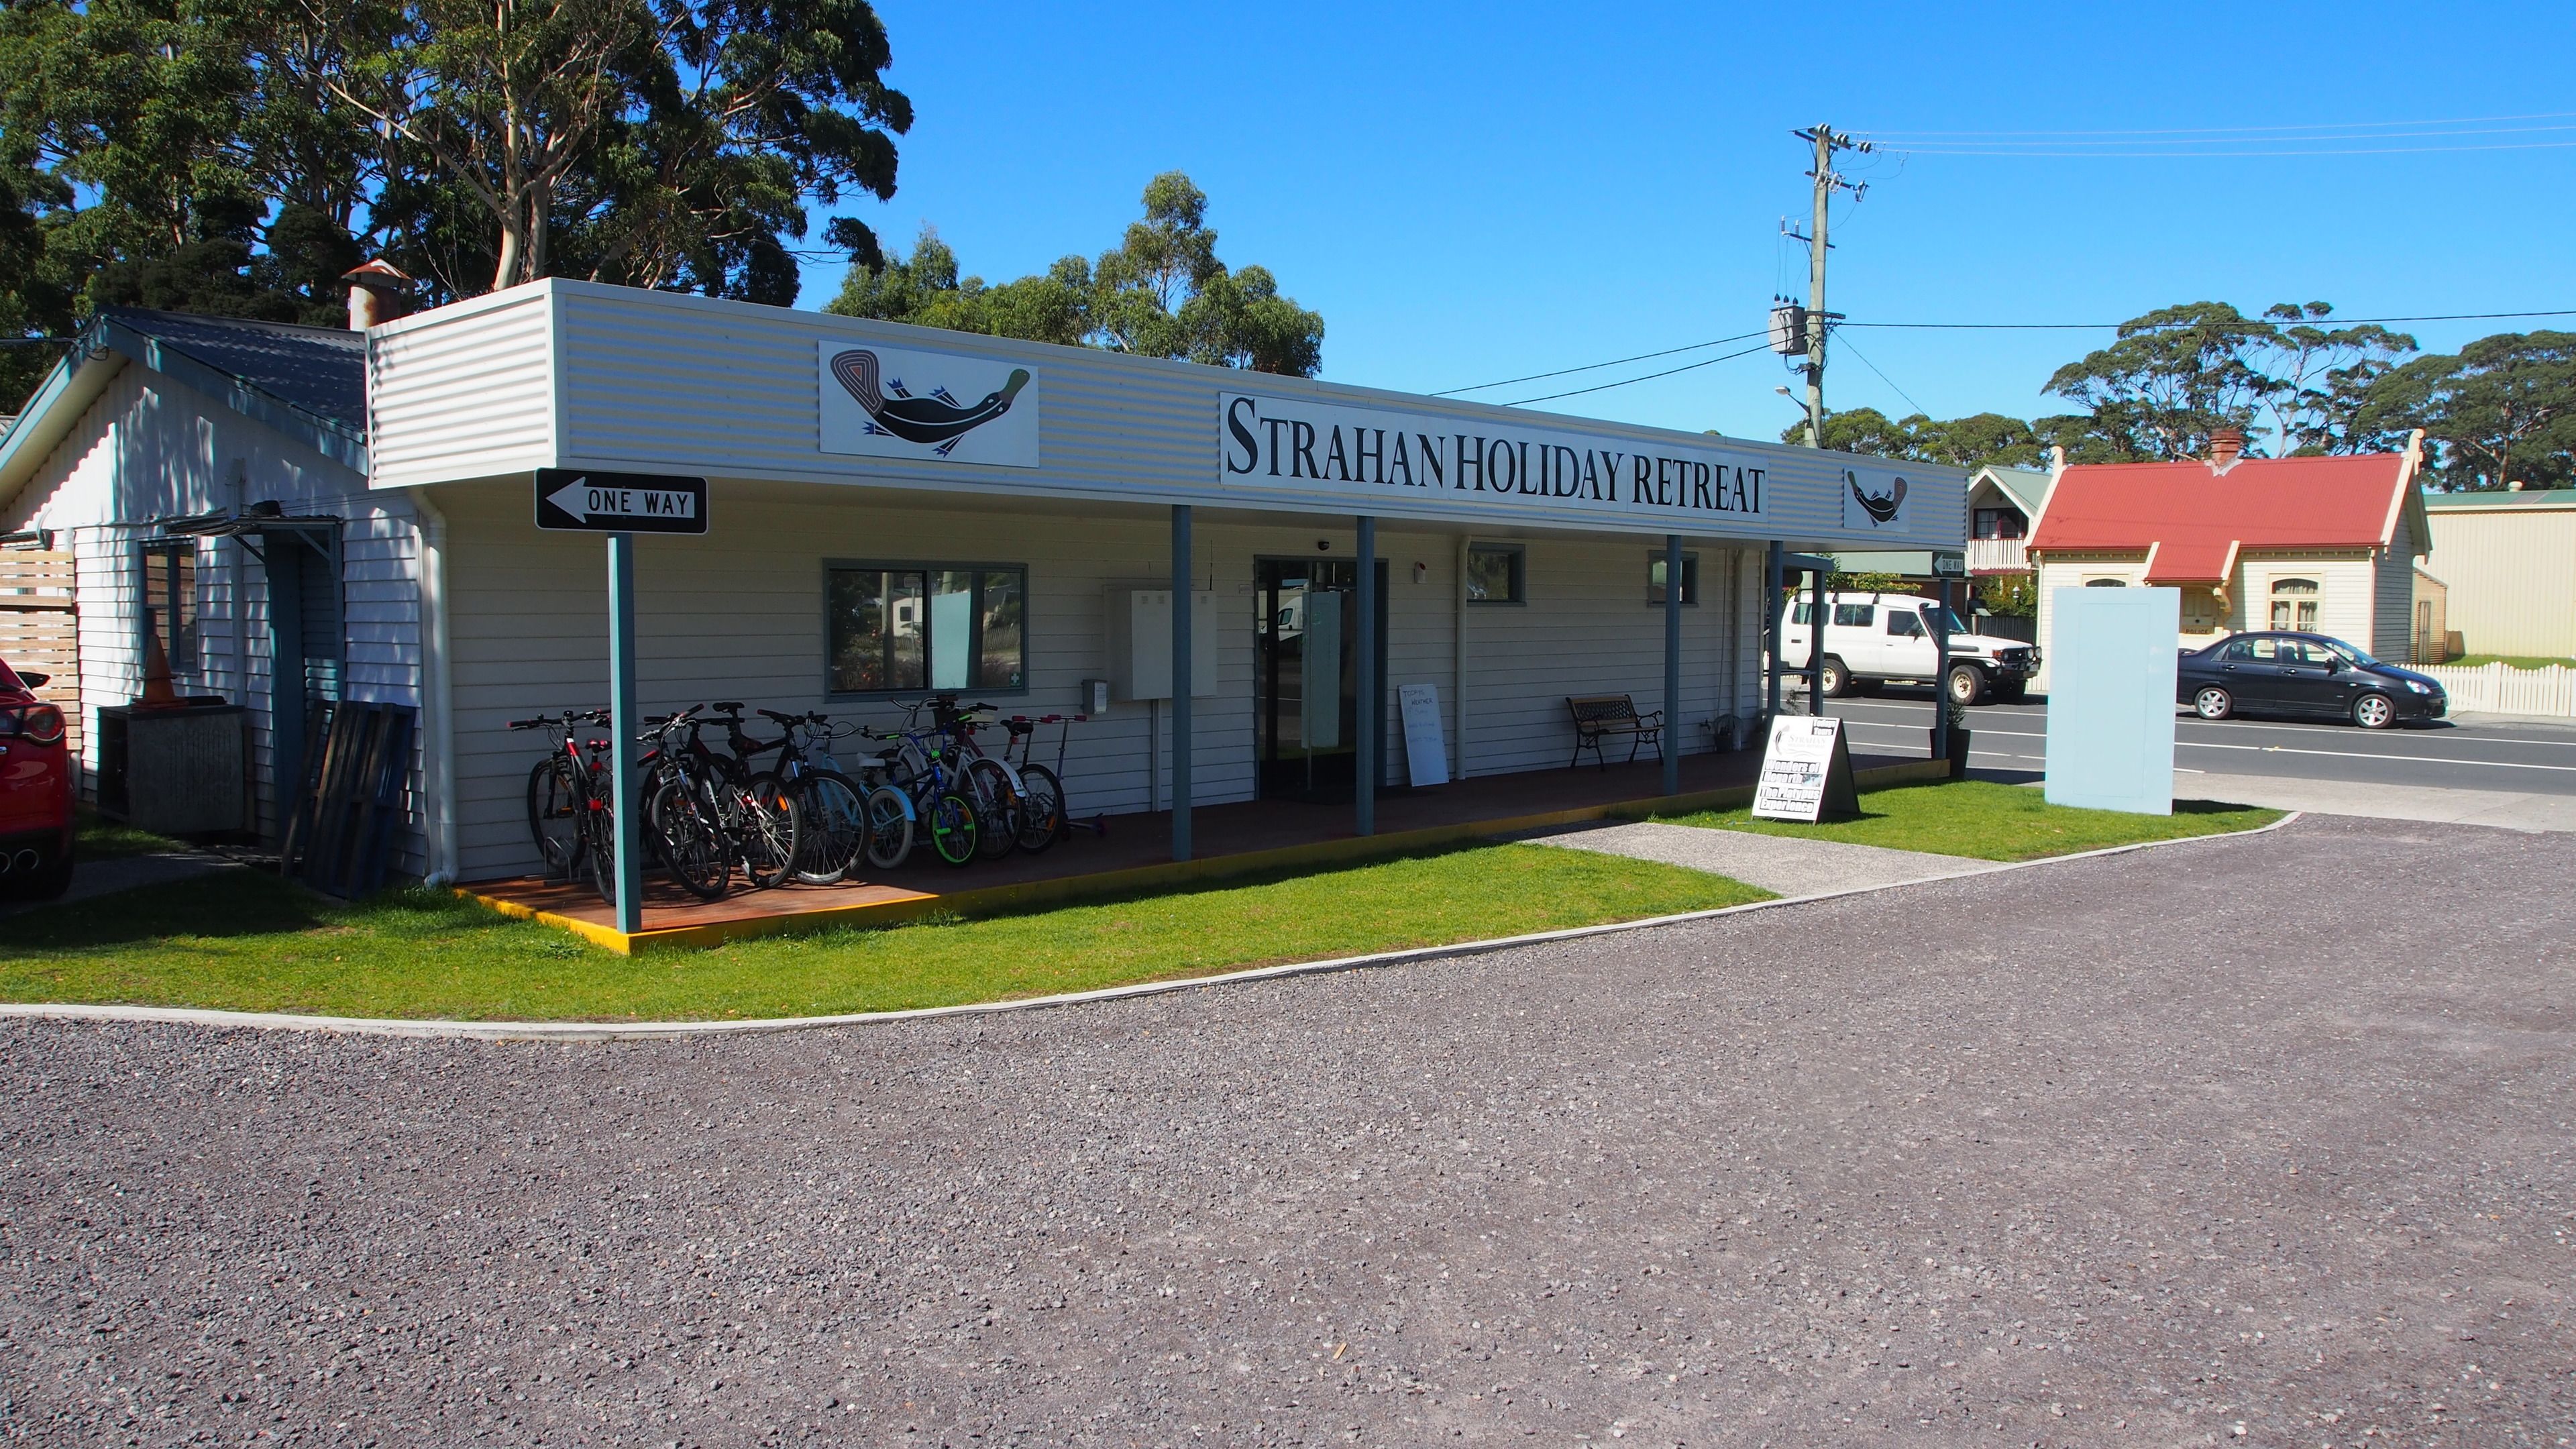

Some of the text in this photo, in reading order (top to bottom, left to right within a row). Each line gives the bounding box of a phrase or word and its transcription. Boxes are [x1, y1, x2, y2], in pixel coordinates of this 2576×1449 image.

[1228, 397, 1765, 514] STRAHAN HOLIDAY RETREAT
[588, 489, 688, 515] ONE WAY
[1943, 559, 1952, 570] ONE
[1813, 727, 1833, 735] Tours
[1765, 759, 1820, 773] Wonders of
[1760, 786, 1821, 800] The Platypus
[1760, 798, 1814, 813] Experience
